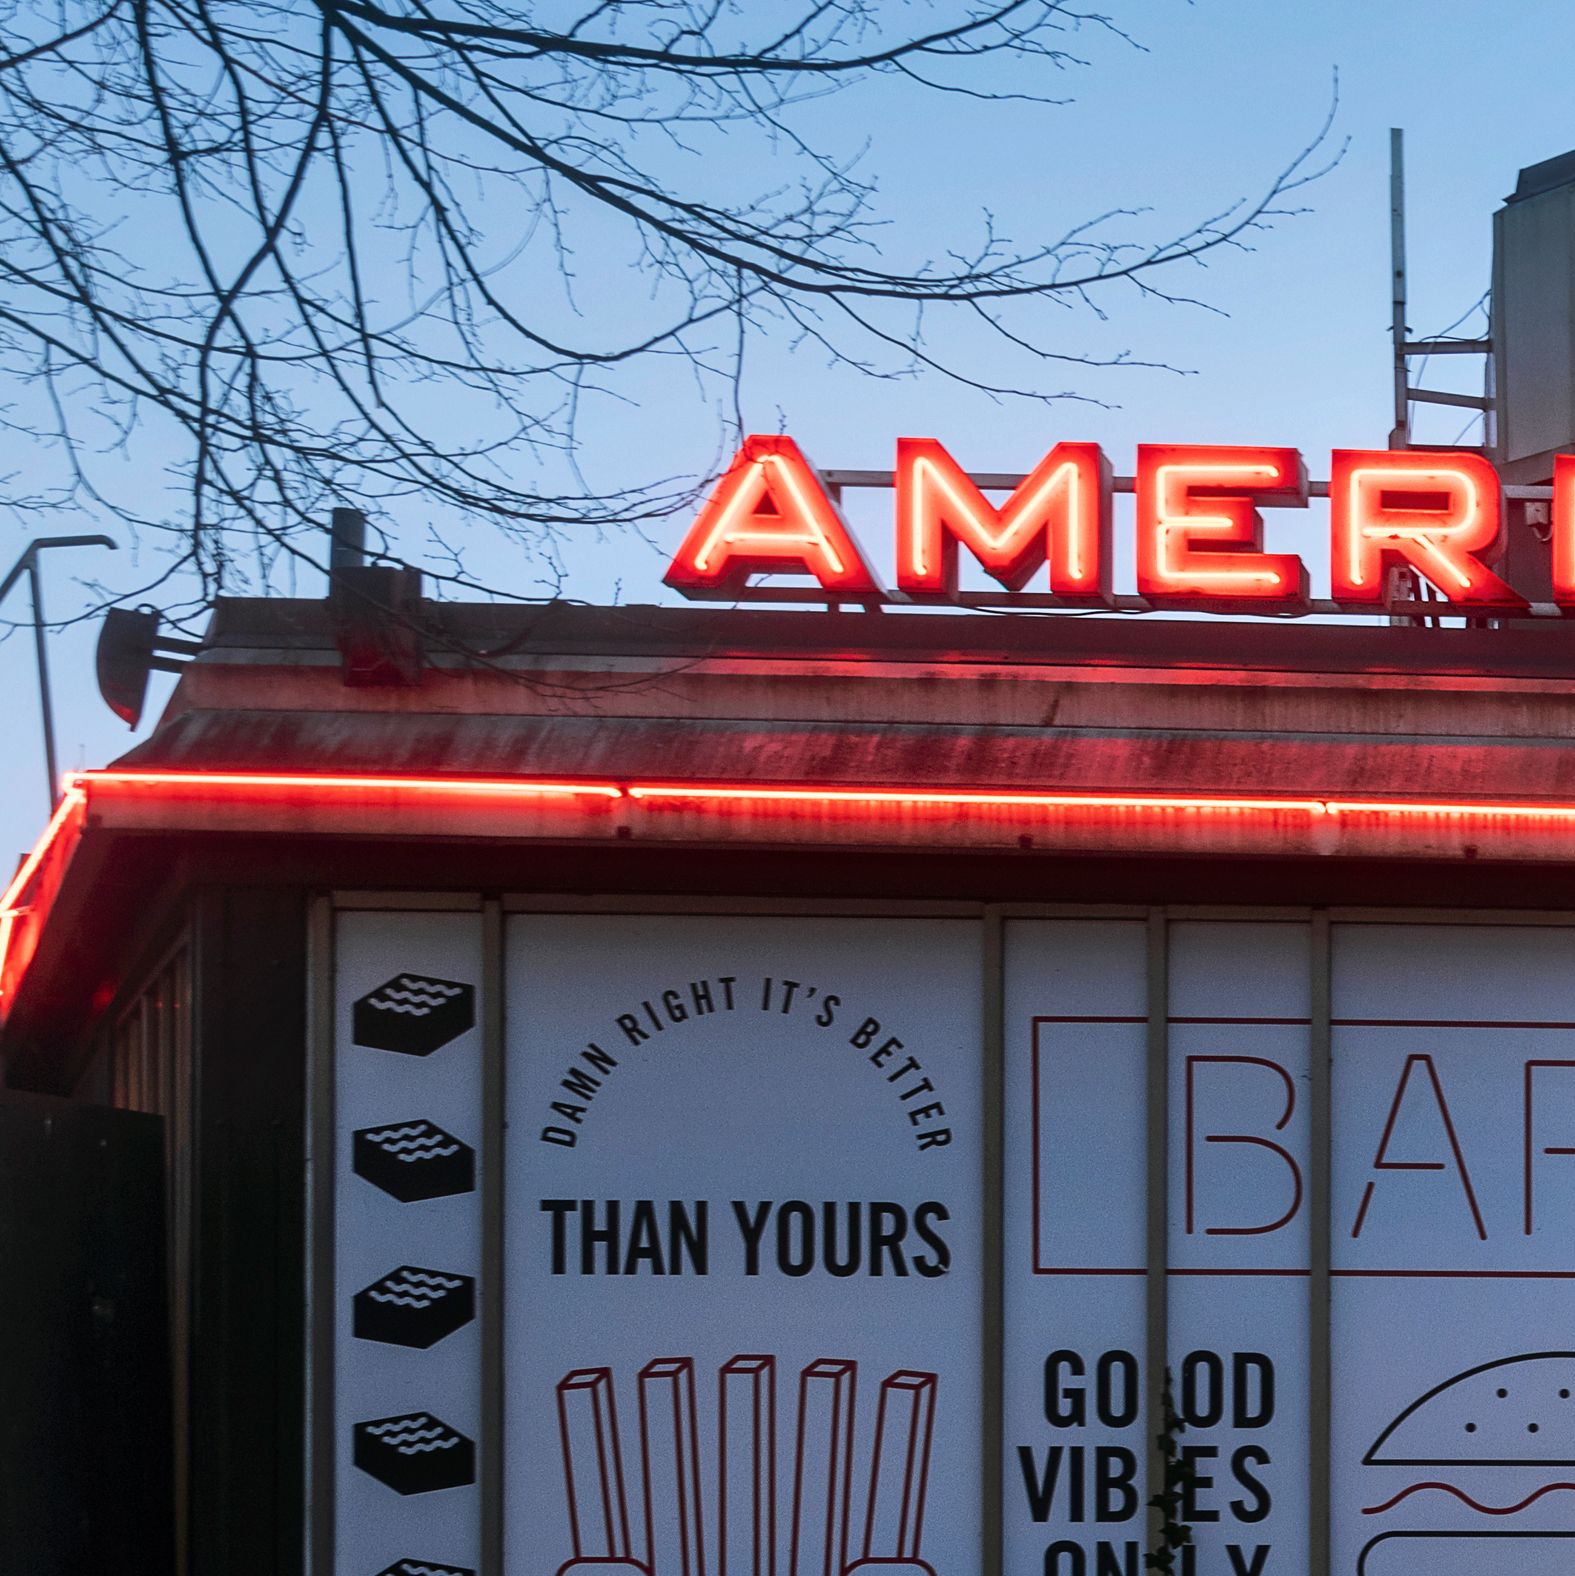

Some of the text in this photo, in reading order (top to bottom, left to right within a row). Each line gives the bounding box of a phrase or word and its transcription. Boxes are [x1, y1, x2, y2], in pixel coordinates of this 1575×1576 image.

[541, 976, 953, 1152] DAMN RIGHT IT'S BETTER
[541, 1199, 953, 1278] THAN YOURS
[1042, 1349, 1275, 1429] GOOD
[1018, 1444, 1272, 1524] VIBES
